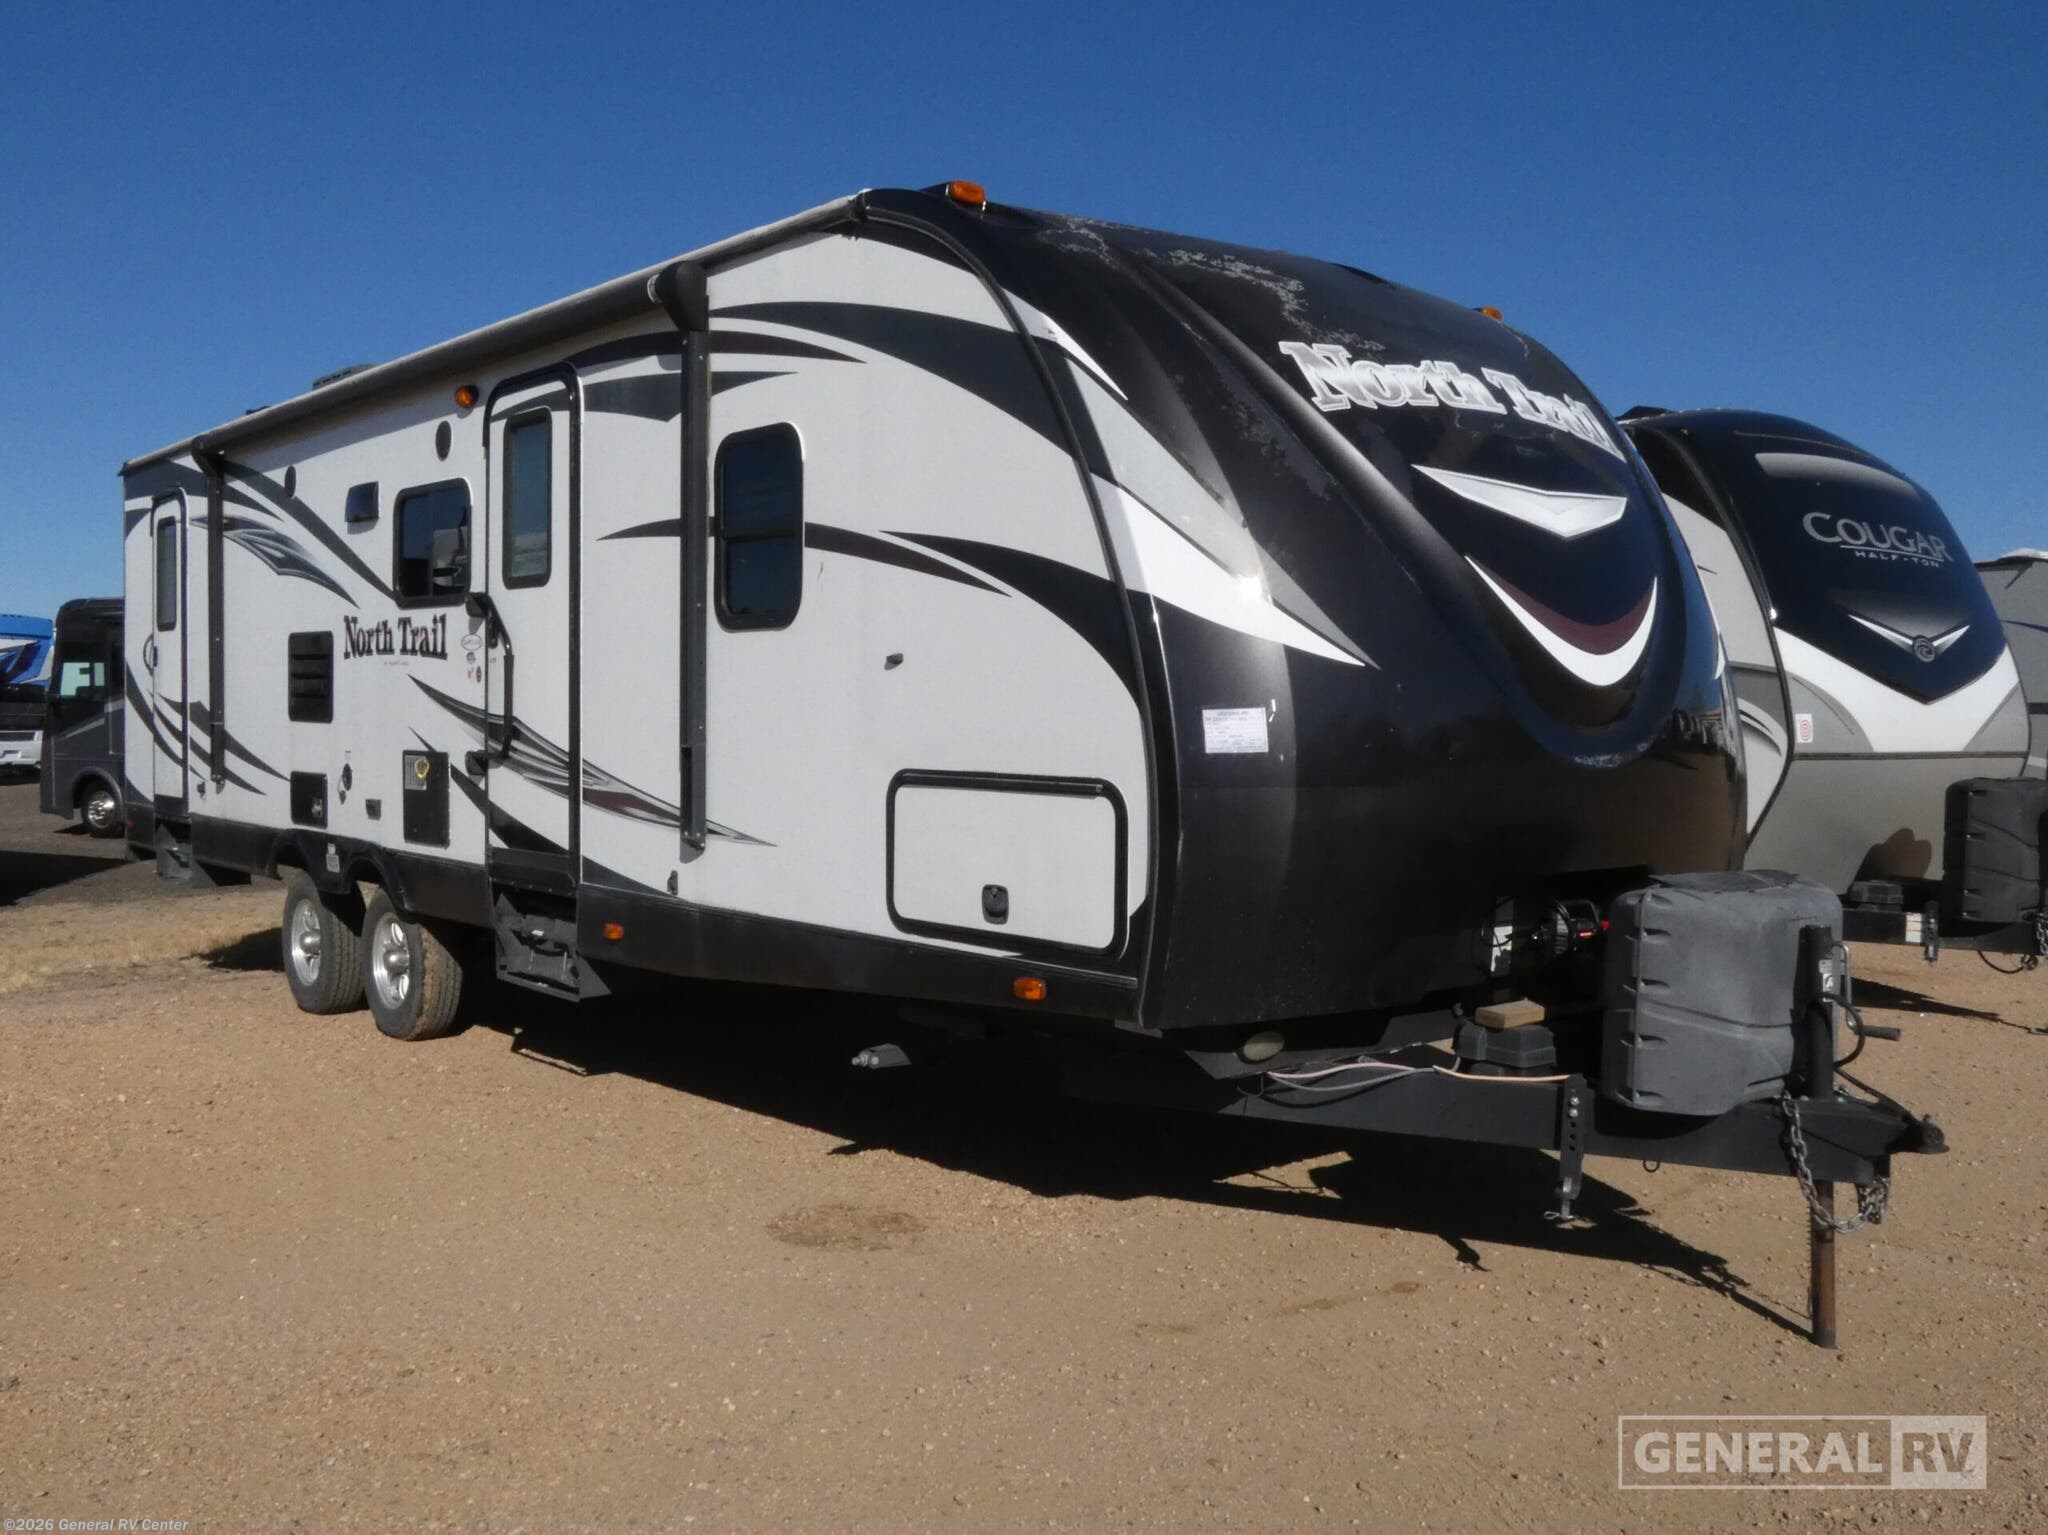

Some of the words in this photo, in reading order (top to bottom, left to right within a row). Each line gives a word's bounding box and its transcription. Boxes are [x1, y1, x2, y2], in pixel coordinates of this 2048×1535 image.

[1279, 341, 1507, 414] North
[1481, 367, 1627, 463] Trail
[1802, 511, 1954, 562] COUGAR
[343, 615, 395, 660] North
[398, 613, 448, 661] Trail
